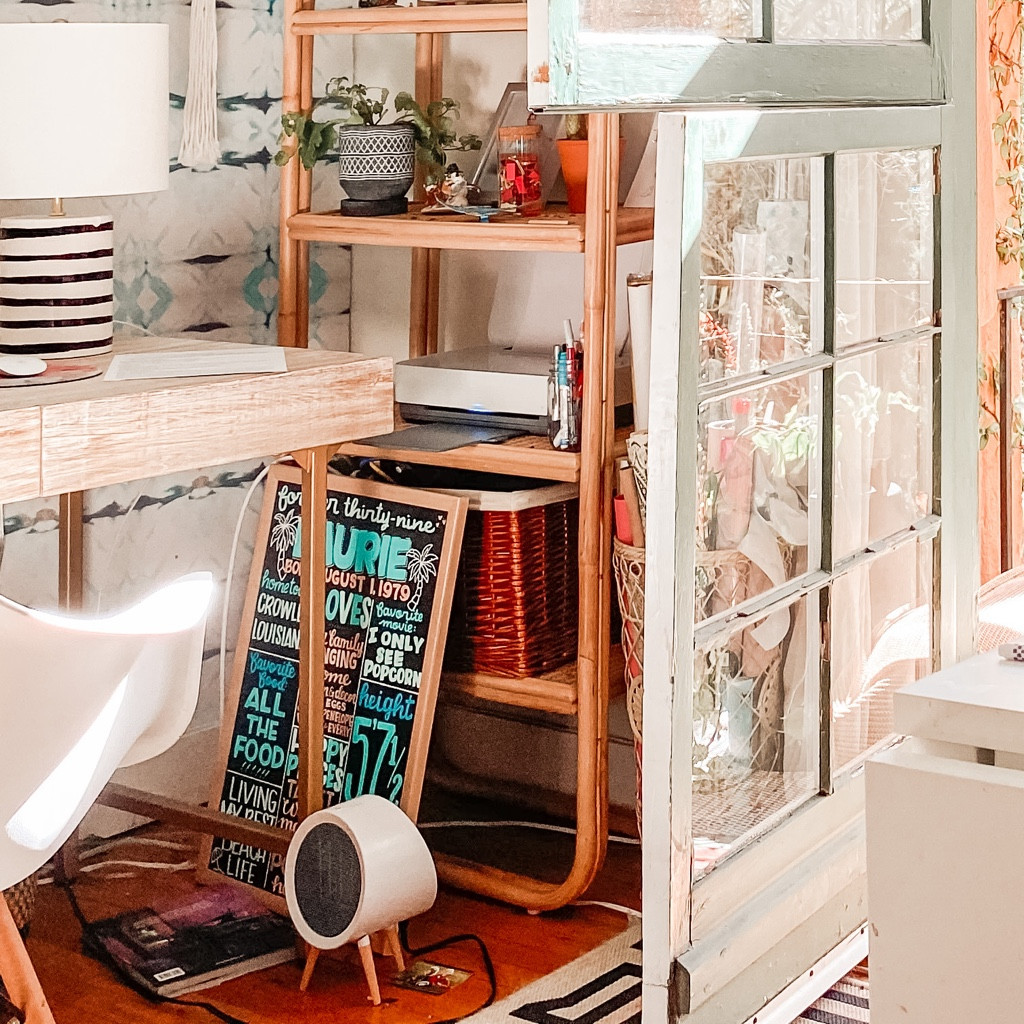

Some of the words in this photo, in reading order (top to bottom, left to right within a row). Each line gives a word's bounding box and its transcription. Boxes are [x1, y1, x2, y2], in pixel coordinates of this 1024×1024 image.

[344, 497, 436, 534] thirty-nine
[325, 568, 366, 594] UGUST
[325, 588, 371, 629] OVES
[376, 602, 424, 623] favorite
[251, 618, 300, 650] LOUISIAN
[380, 631, 425, 655] ONLY
[250, 652, 296, 678] favorite
[375, 646, 404, 667] SEE
[363, 659, 422, 688] POPCORN
[244, 687, 286, 718] ALL
[325, 698, 347, 711] EGGS
[358, 682, 415, 721] height
[246, 714, 279, 741] THE
[233, 735, 285, 769] FOOD
[229, 776, 278, 813] LIVING
[227, 854, 257, 884] LIFE
